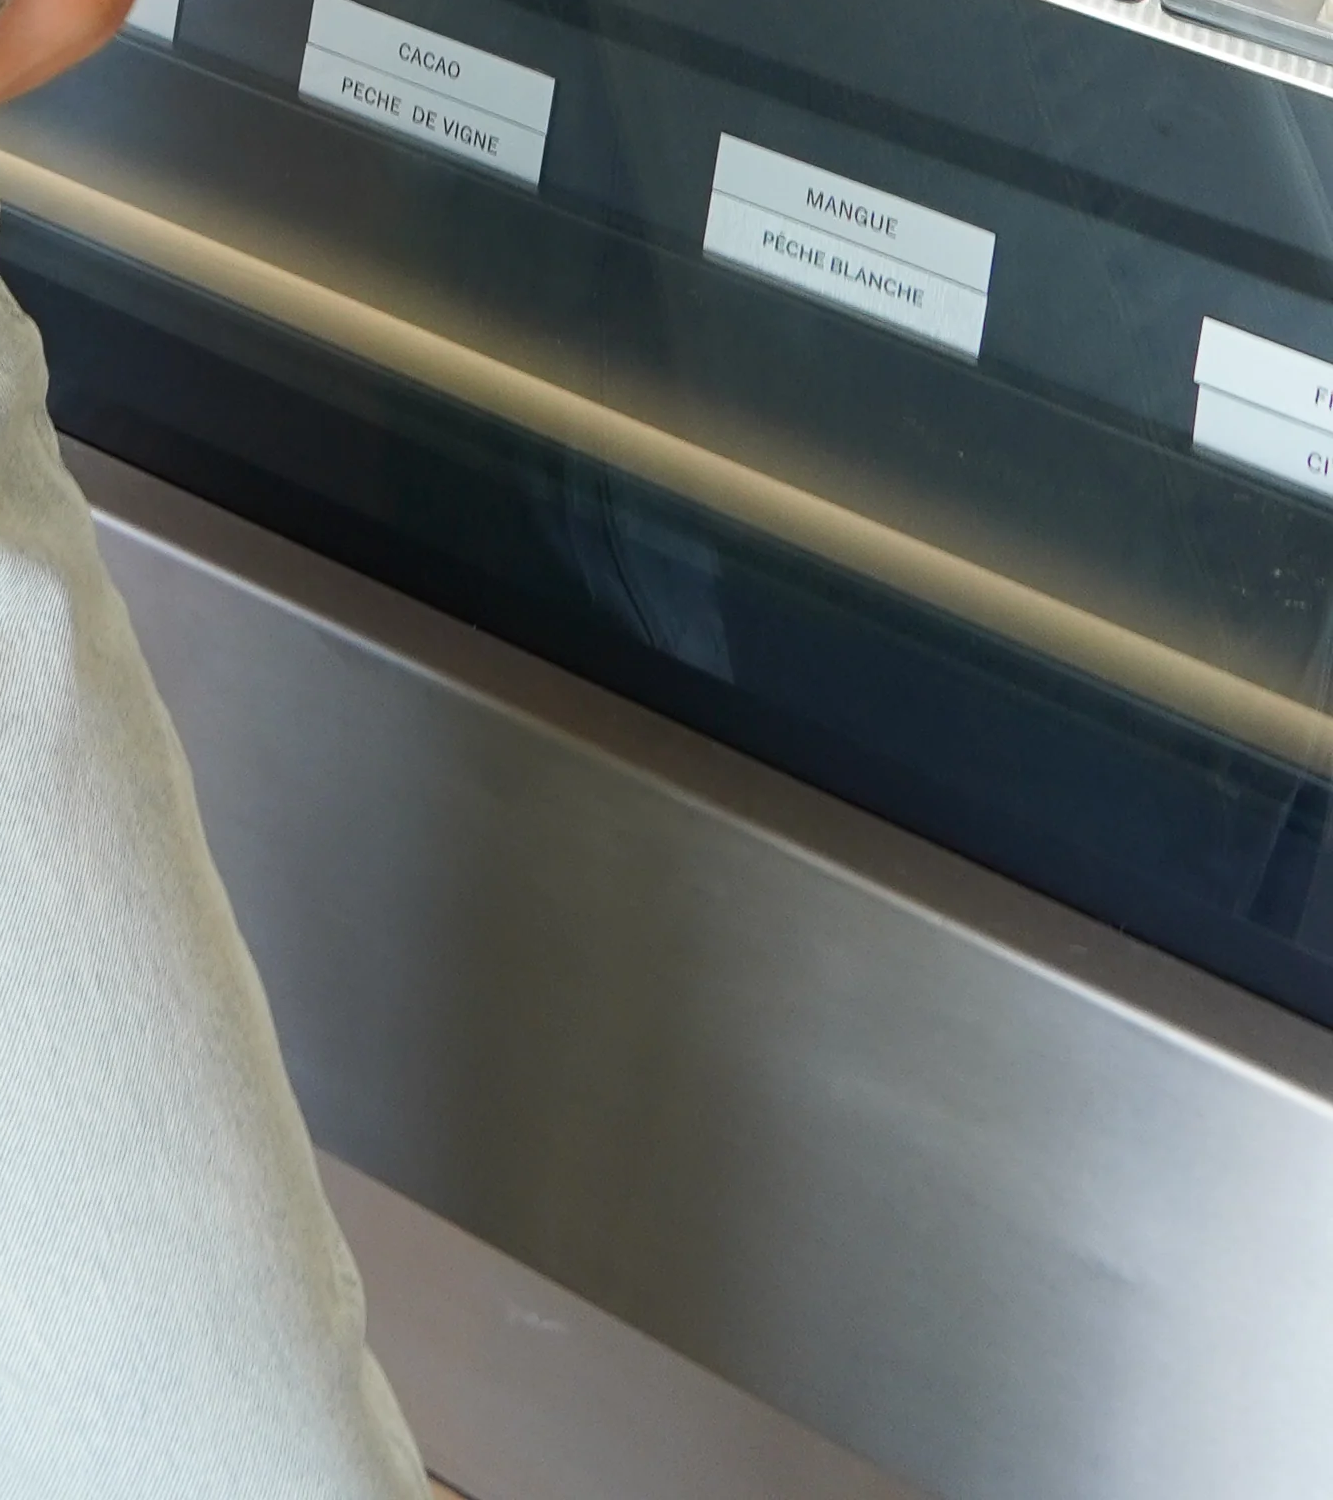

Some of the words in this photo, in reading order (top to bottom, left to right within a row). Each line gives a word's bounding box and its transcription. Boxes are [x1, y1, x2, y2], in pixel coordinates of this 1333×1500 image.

[398, 42, 461, 80] CACAO
[341, 76, 401, 117] PECHE
[412, 105, 437, 132] DE
[443, 115, 499, 156] VIGNE
[806, 186, 898, 239] MANGUE
[830, 254, 924, 308] BLANCHE
